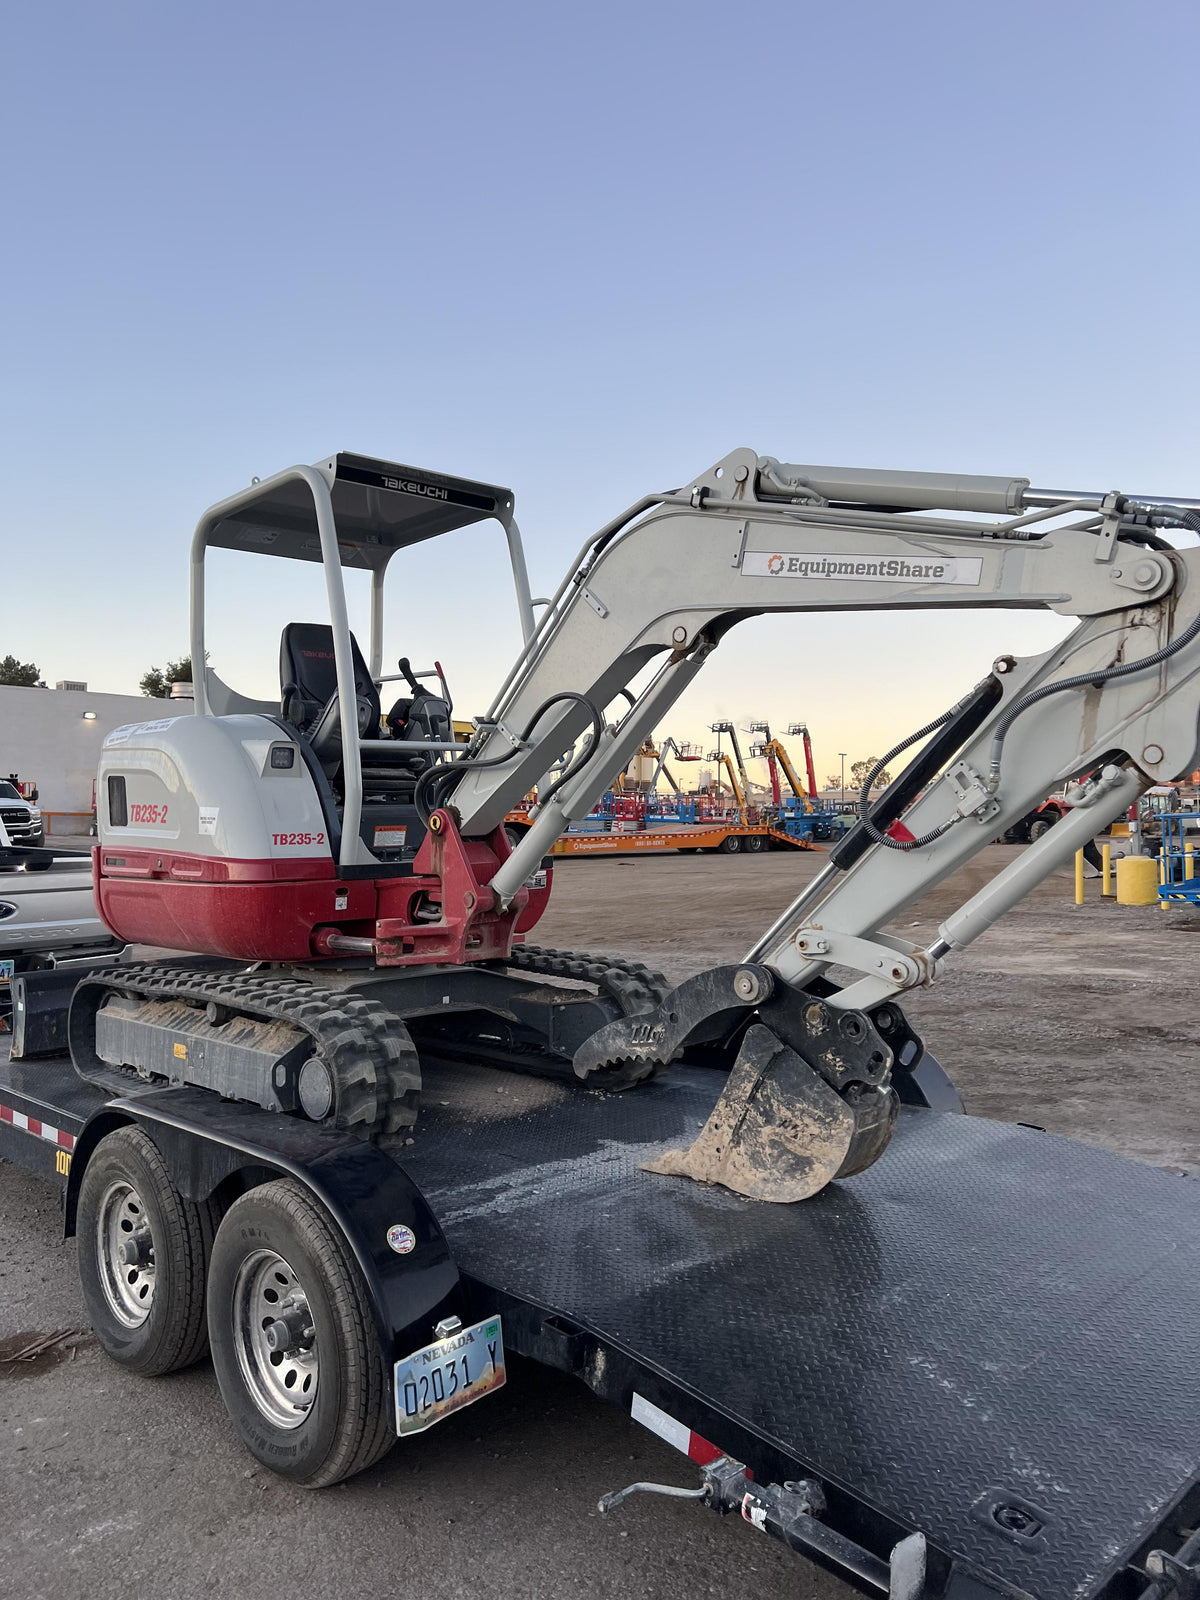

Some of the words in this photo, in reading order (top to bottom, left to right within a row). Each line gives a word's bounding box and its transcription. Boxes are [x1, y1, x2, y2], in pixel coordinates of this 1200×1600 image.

[787, 557, 944, 578] EquipmentShare
[130, 804, 168, 824] TB235-2
[271, 833, 325, 846] TB235-2
[421, 1332, 475, 1365] NEVADA
[487, 1340, 497, 1373] Y
